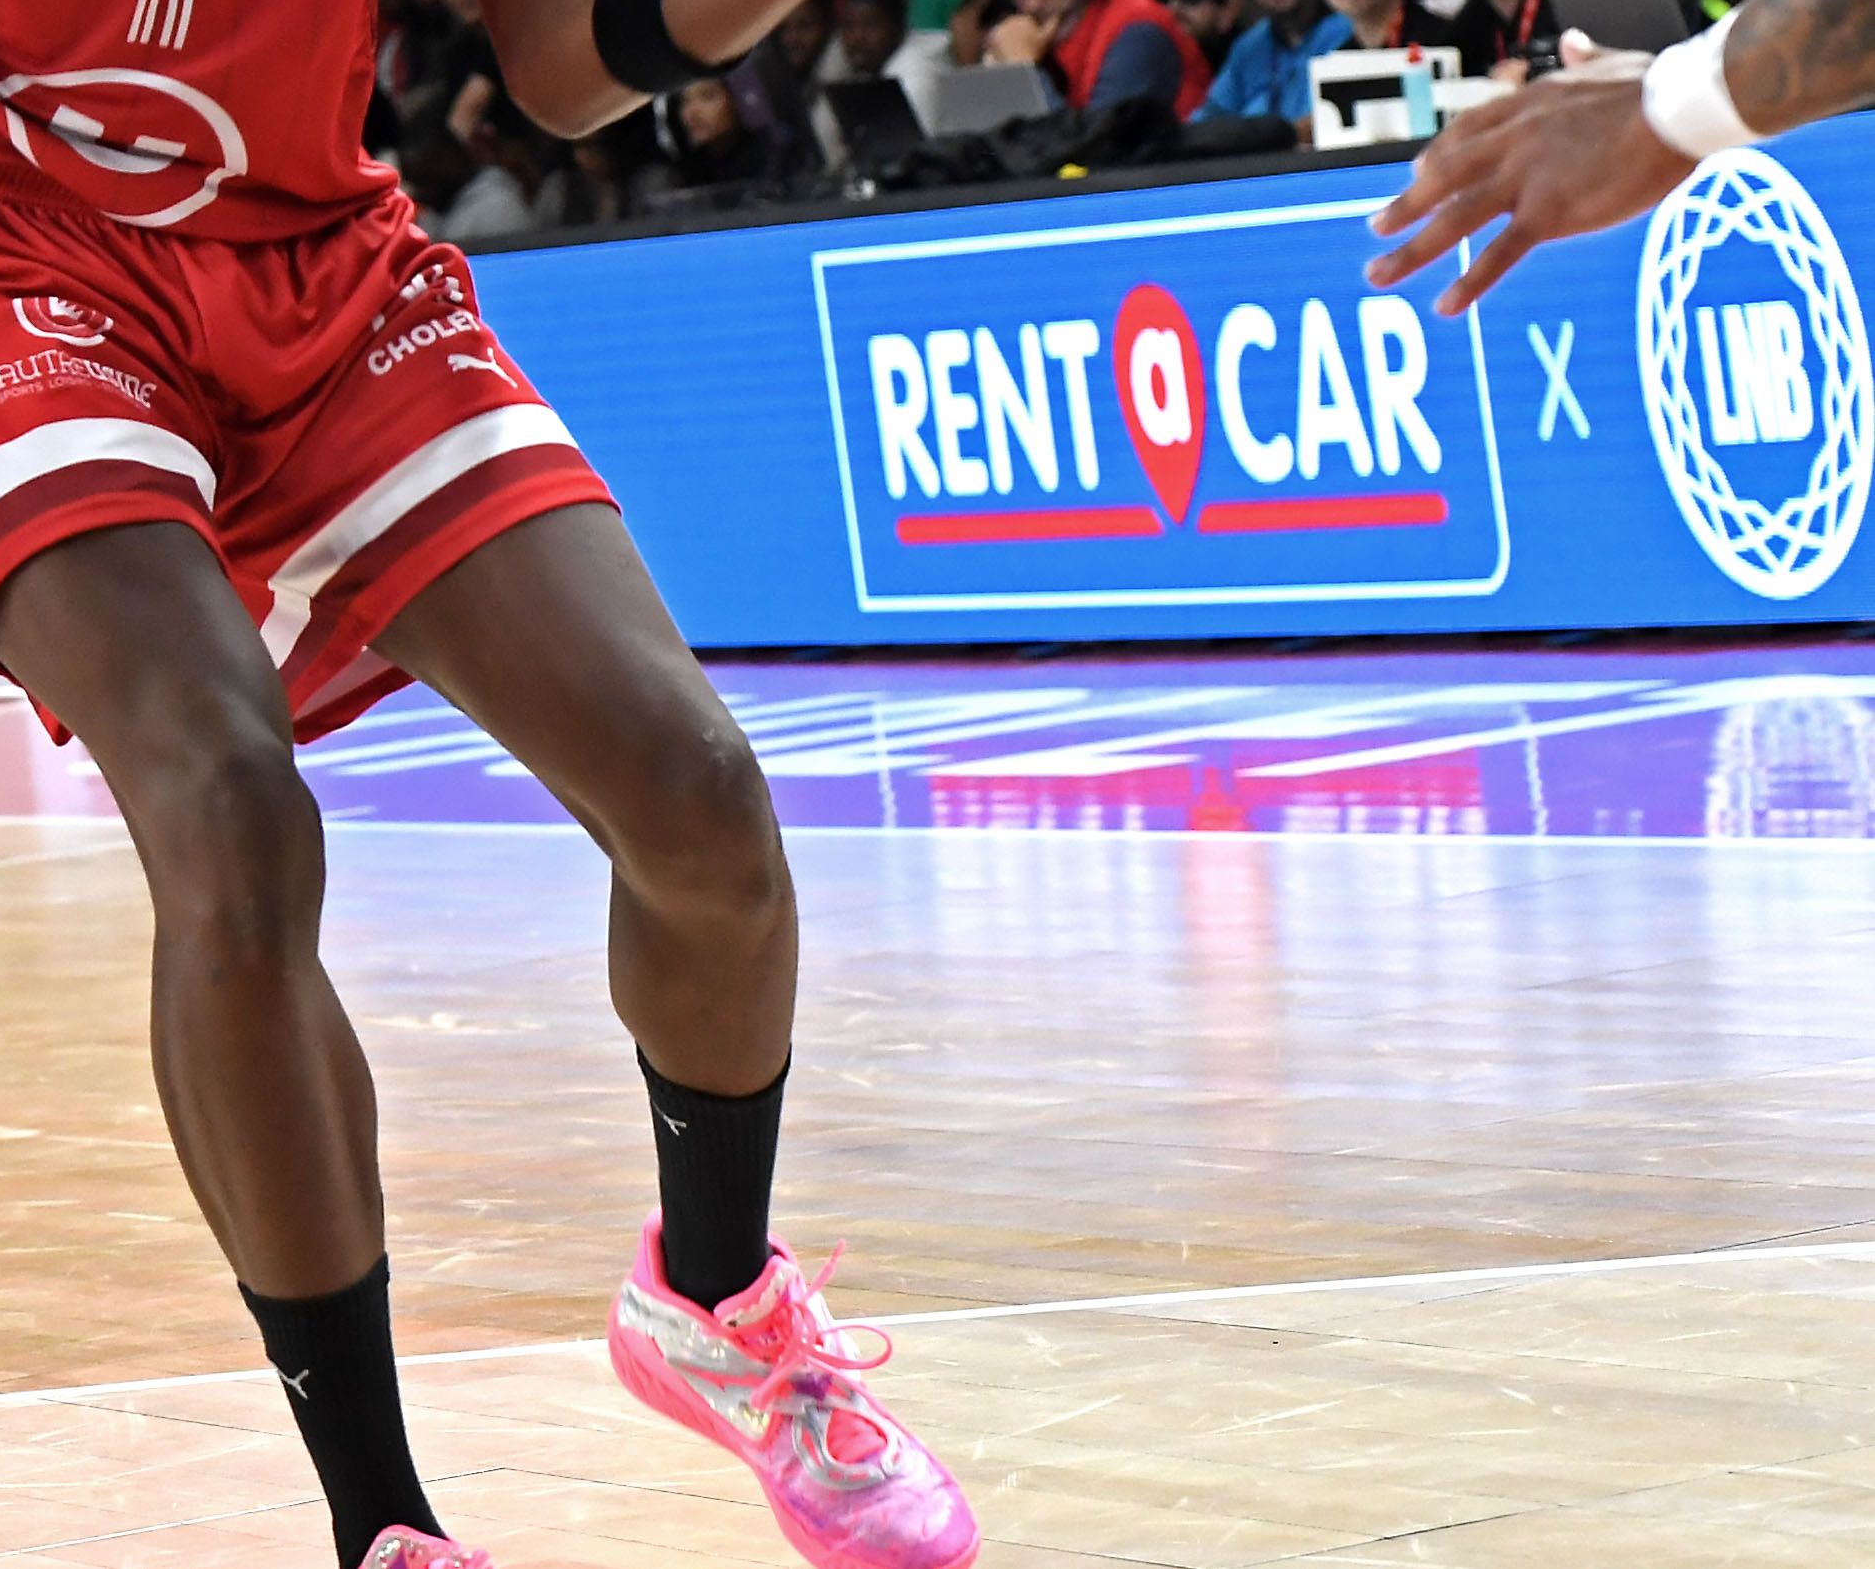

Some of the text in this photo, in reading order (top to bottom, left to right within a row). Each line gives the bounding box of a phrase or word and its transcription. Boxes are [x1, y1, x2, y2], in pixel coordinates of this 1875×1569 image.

[868, 295, 1442, 498] RENT a CAR
[1696, 300, 1814, 446] LNB
